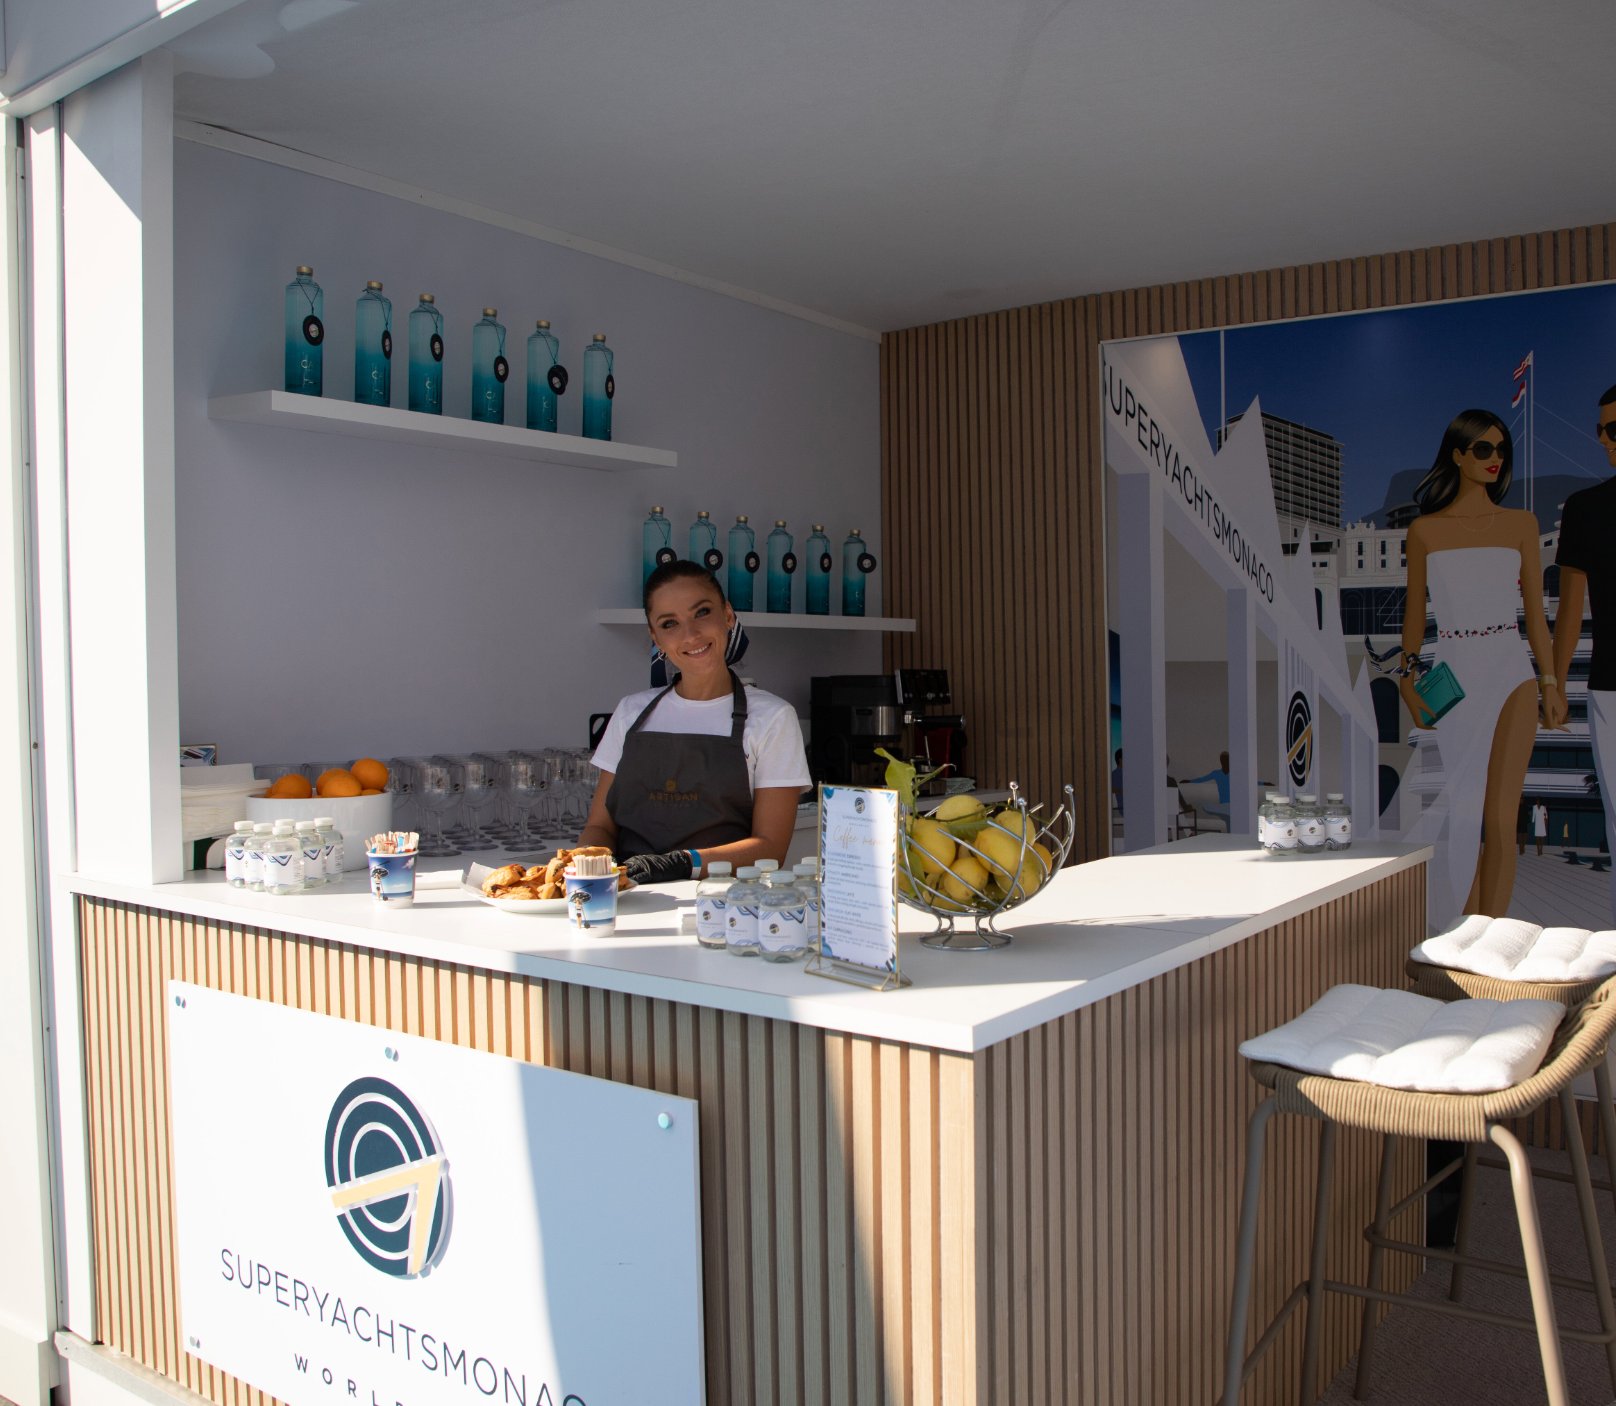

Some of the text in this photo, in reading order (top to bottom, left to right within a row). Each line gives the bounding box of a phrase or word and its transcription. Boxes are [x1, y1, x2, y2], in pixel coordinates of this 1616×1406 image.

[648, 792, 699, 801] ARTISAN
[221, 1248, 587, 1406] SUPERYACHTSMONA
[295, 1353, 404, 1406] WORL
